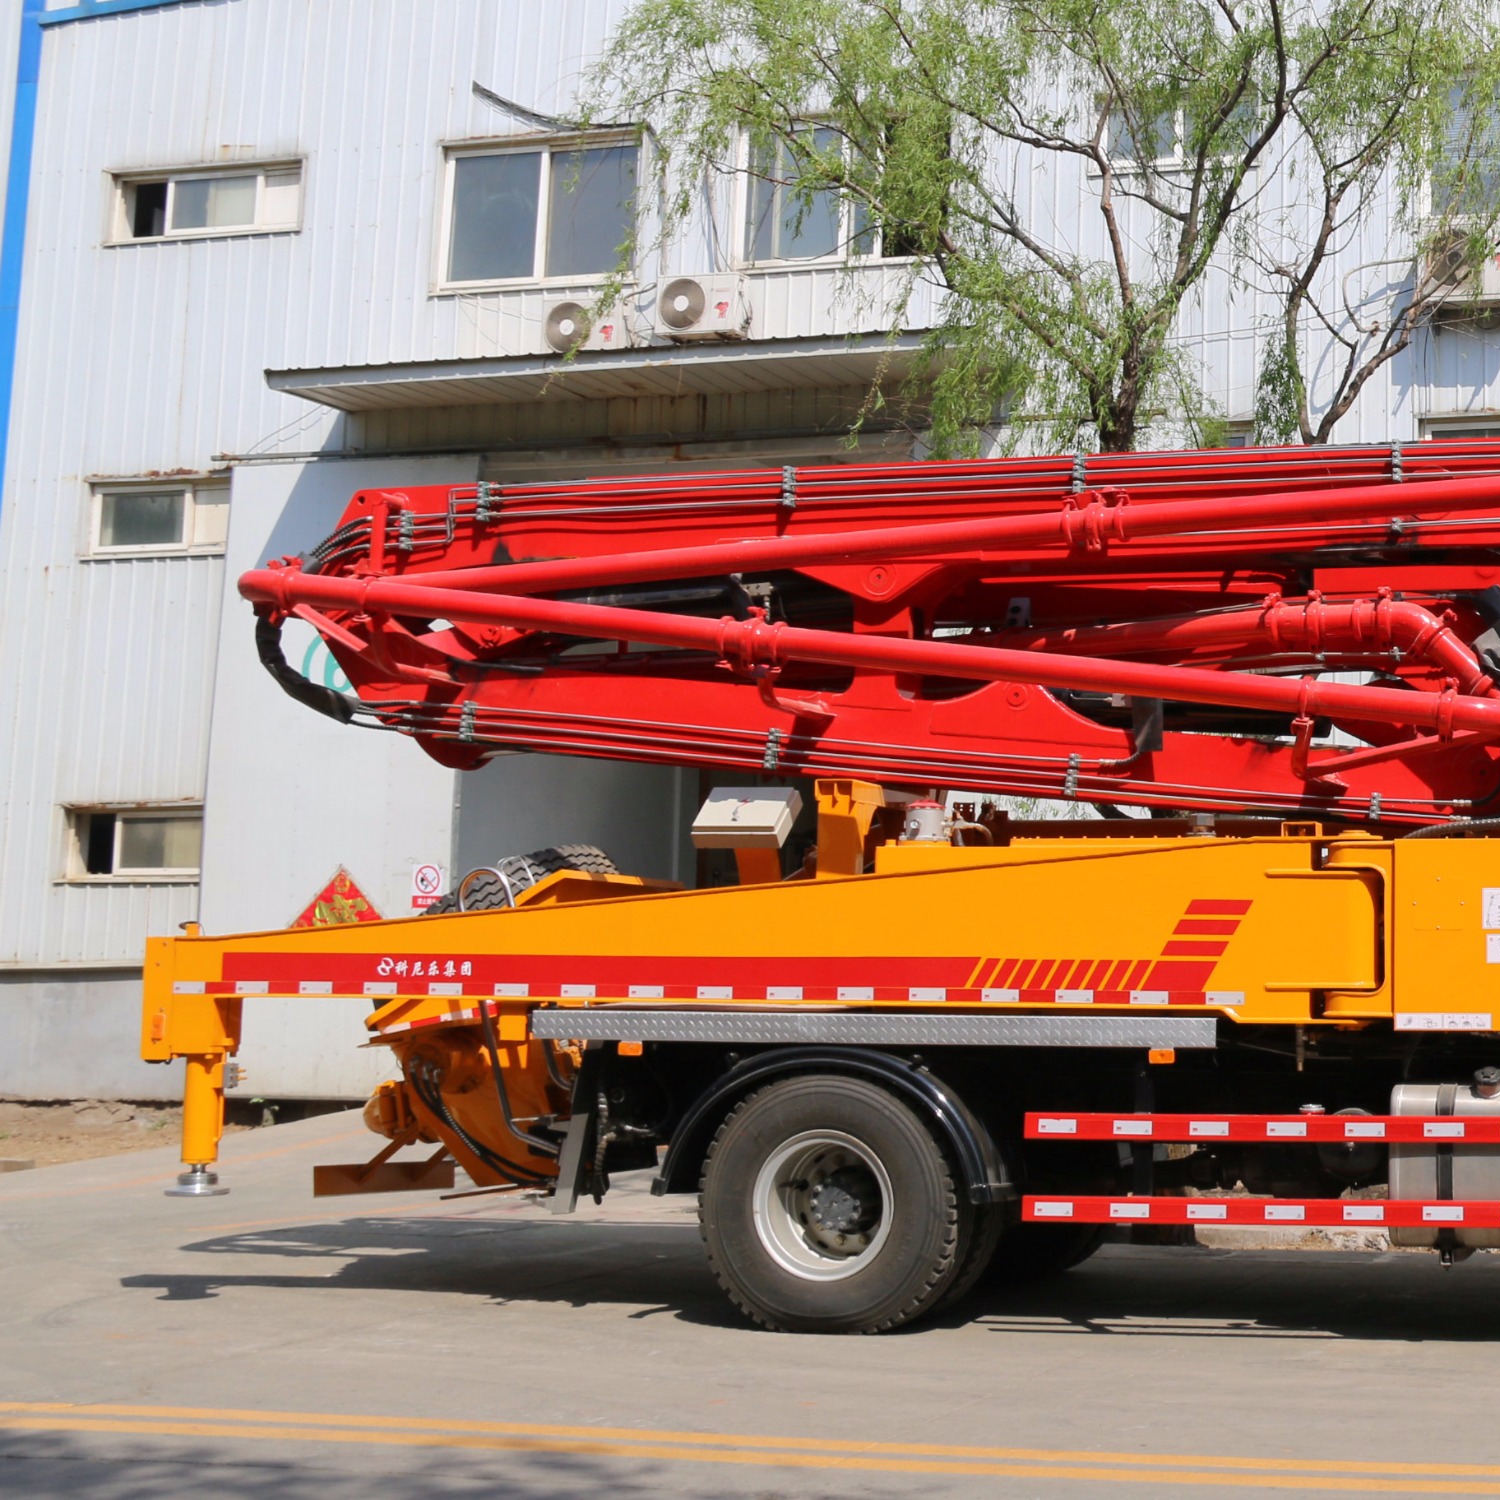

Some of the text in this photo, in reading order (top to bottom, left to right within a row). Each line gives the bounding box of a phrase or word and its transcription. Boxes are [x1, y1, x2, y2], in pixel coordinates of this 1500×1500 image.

[395, 960, 473, 977] 科尼乐集团
